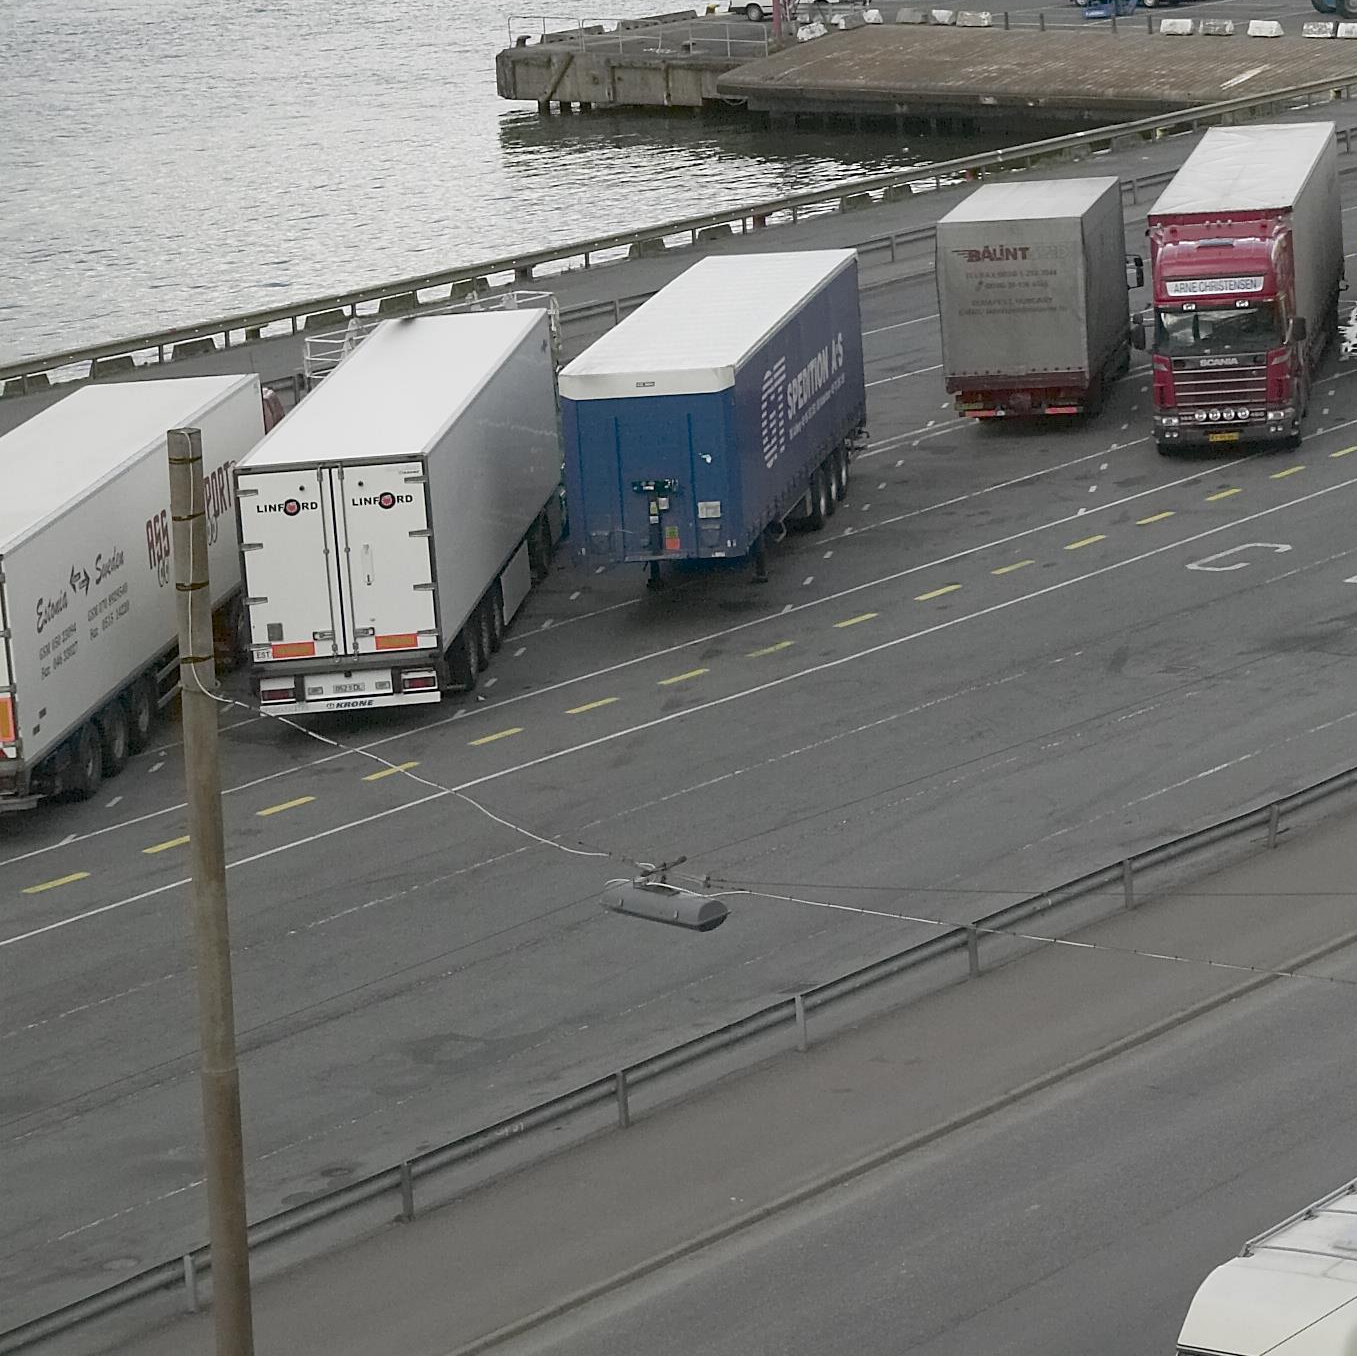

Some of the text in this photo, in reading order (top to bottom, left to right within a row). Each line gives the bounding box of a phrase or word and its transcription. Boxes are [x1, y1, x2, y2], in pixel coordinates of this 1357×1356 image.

[1174, 278, 1258, 294] ARNE CHRISTENSEN
[1199, 357, 1239, 367] SCANIA
[787, 345, 829, 421] SPEDITION
[256, 497, 318, 517] LINFORD
[352, 491, 413, 510] LINFORD
[36, 546, 125, 634] Estonia Sweden
[256, 650, 271, 660] EST
[335, 699, 374, 708] KRONE
